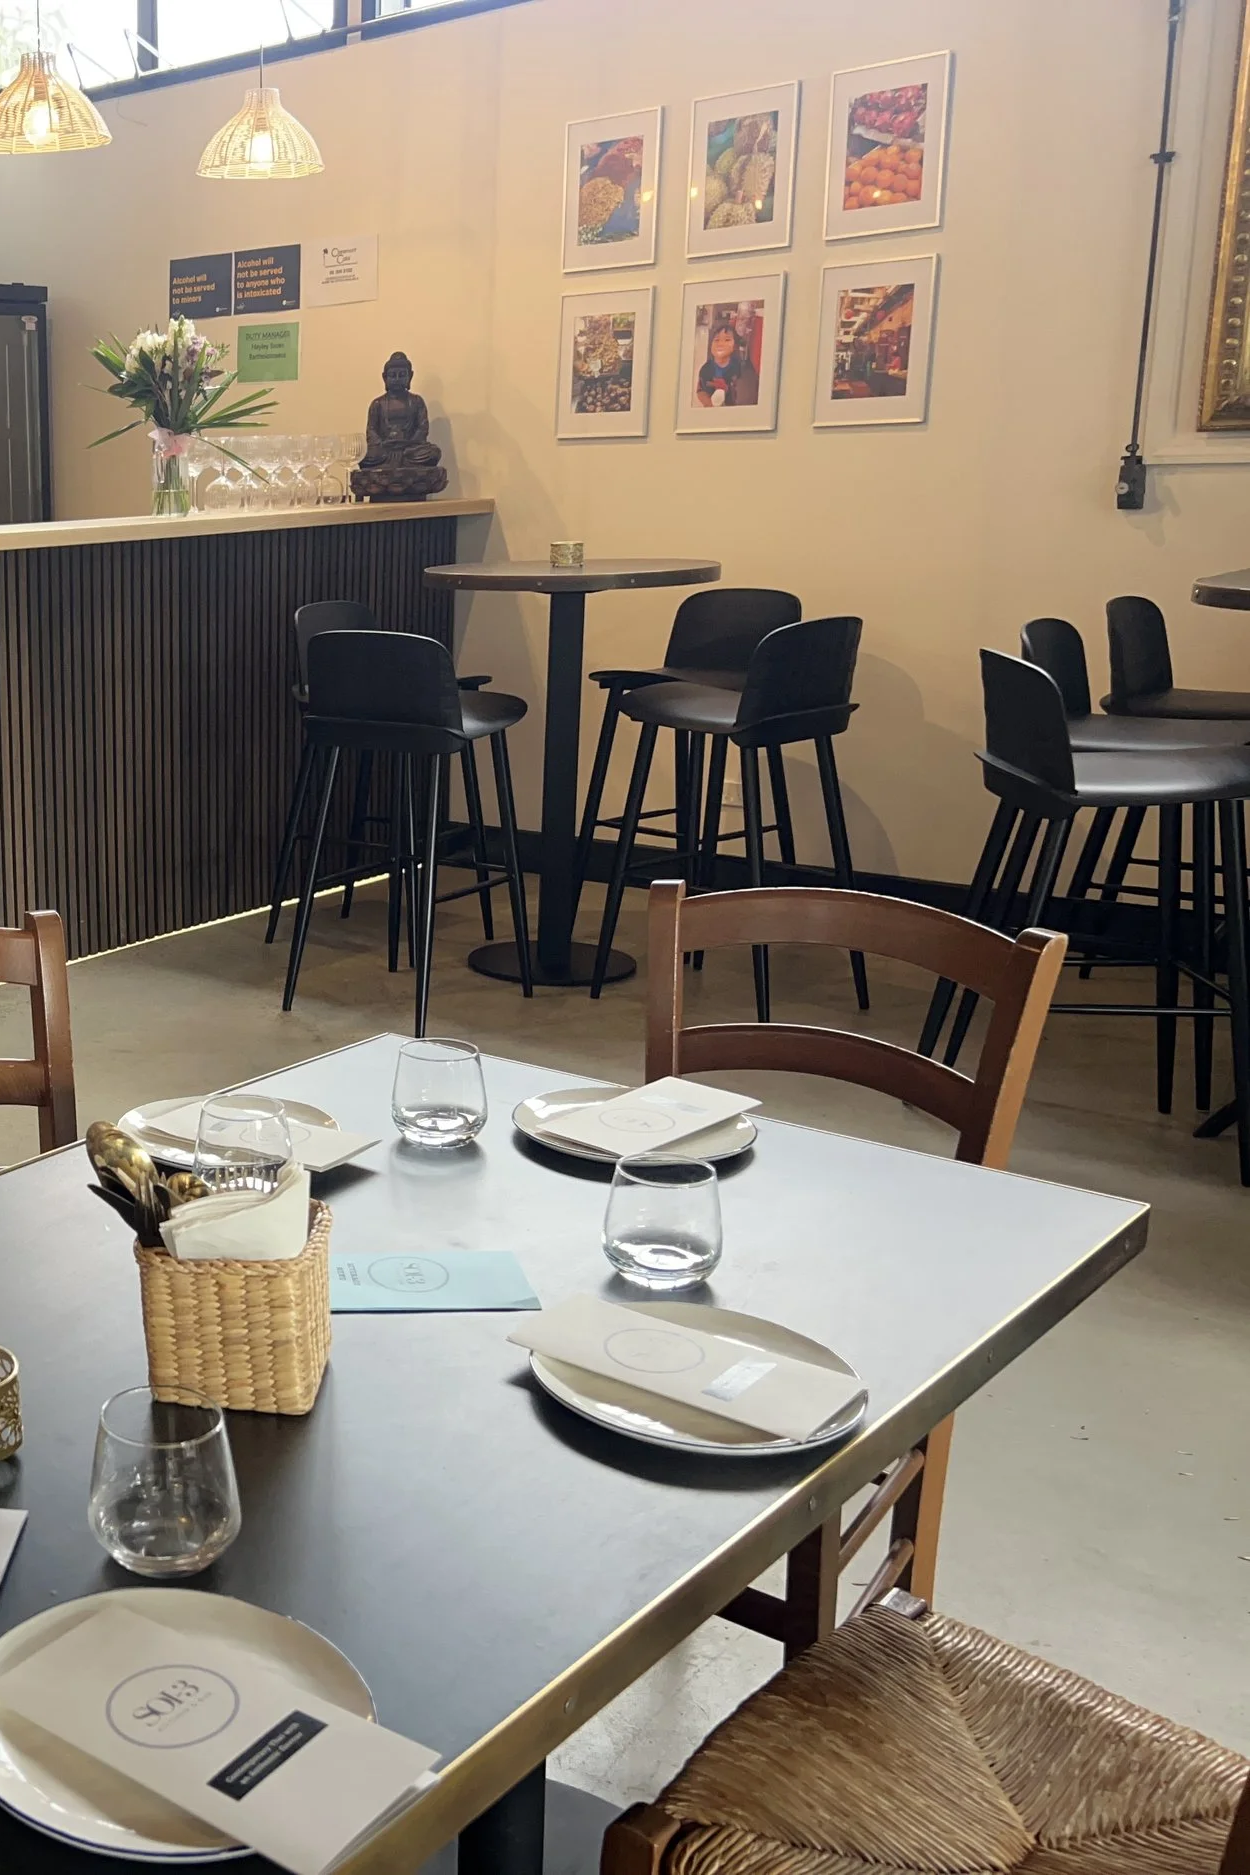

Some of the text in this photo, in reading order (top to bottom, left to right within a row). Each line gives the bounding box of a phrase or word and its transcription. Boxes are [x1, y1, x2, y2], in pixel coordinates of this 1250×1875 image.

[238, 256, 274, 268] Alcohol will
[237, 266, 283, 279] not be served
[172, 275, 196, 285] Alcohol
[236, 276, 286, 289] to anyone who
[193, 282, 215, 293] served
[237, 286, 282, 299] is intoxicated
